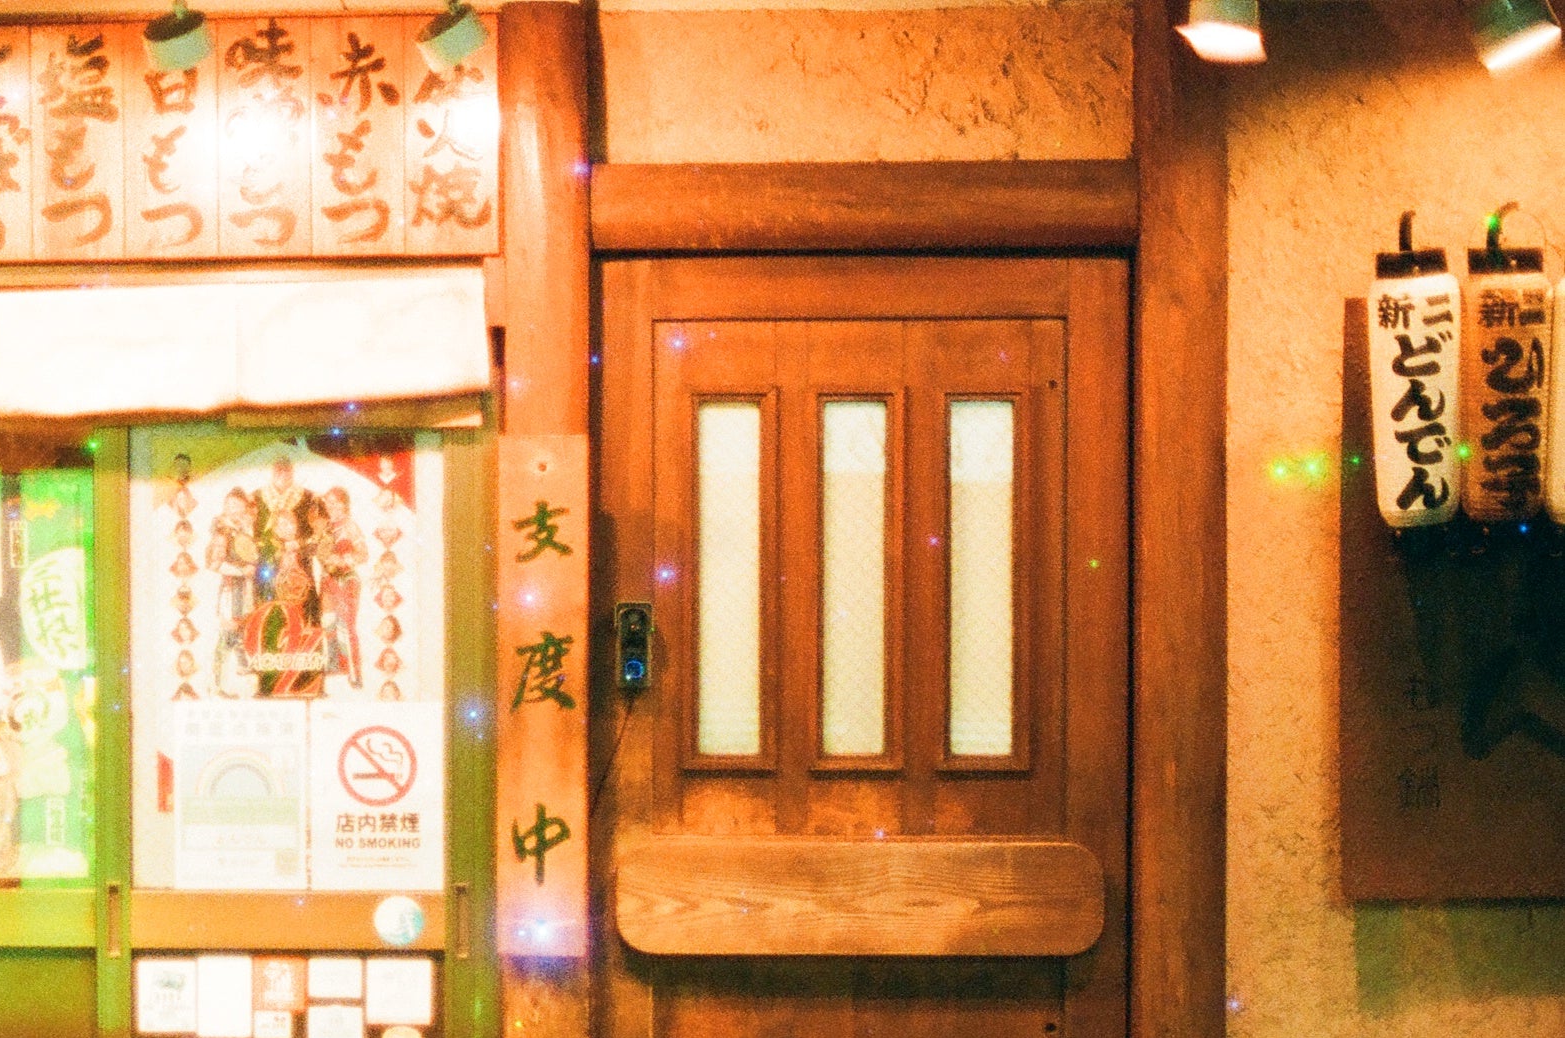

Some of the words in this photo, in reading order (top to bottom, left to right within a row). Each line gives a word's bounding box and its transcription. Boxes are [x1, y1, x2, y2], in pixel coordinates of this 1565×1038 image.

[37, 33, 120, 248] 塩もつ
[316, 31, 400, 245] 赤もつ
[1391, 331, 1453, 511] どんでん
[510, 500, 576, 887] 支度中
[335, 838, 354, 849] NO
[358, 838, 421, 849] SMOKING
[336, 812, 420, 833] 店内禁煙
